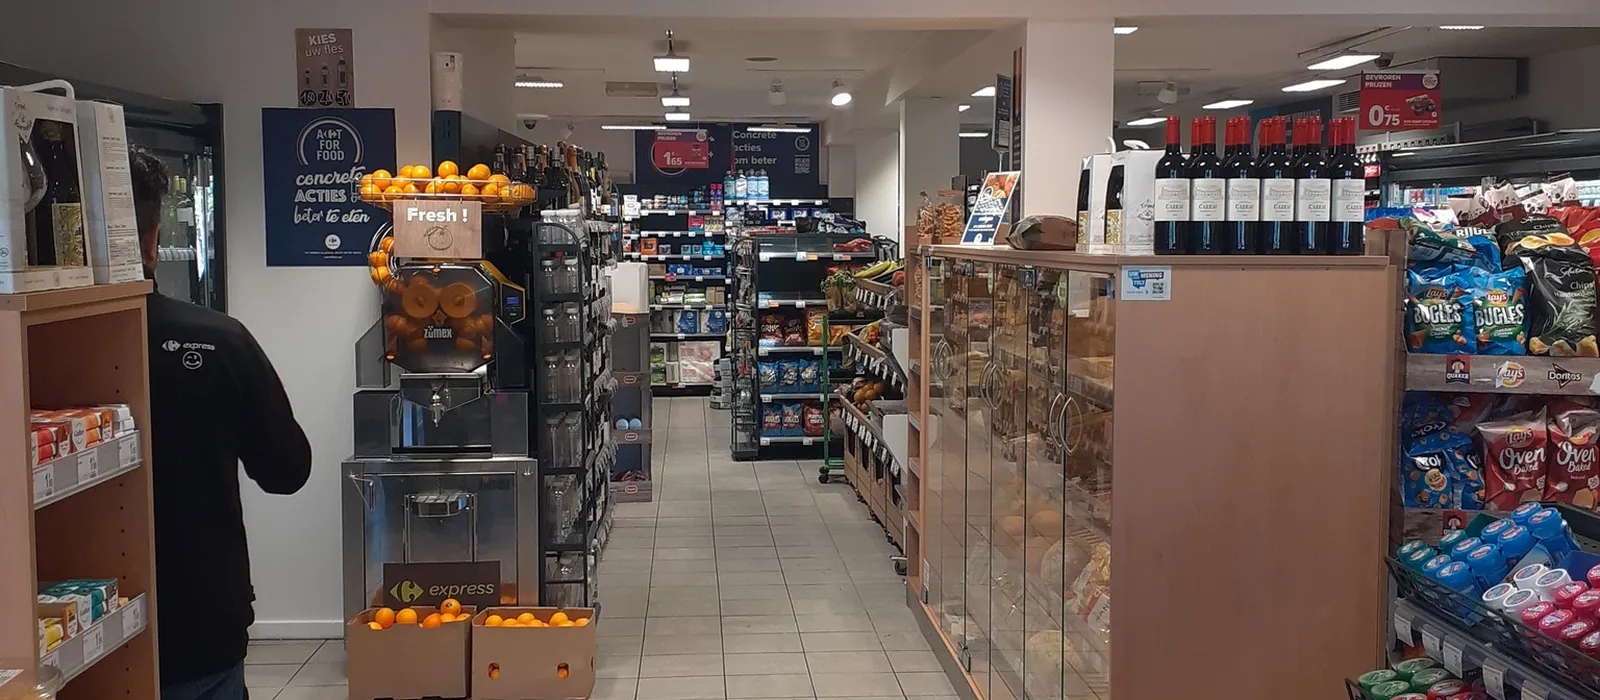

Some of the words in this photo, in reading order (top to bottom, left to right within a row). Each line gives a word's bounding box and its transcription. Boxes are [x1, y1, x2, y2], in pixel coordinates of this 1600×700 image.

[308, 32, 337, 46] KIES
[305, 47, 321, 57] uw
[325, 44, 344, 54] fles
[732, 130, 778, 139] Concrete
[320, 140, 340, 150] FOR
[317, 151, 344, 161] FOOD
[751, 156, 778, 165] beter
[296, 166, 366, 186] concrete
[294, 189, 347, 202] ACTIES
[294, 205, 324, 224] beter
[326, 209, 340, 223] te
[342, 209, 370, 223] eten
[407, 207, 457, 223] Fresh
[1570, 281, 1594, 290] Chips
[1413, 302, 1462, 324] BUGLES
[1475, 303, 1524, 327] BUGLES
[182, 342, 215, 350] express
[1446, 372, 1469, 380] QUAKER
[1549, 371, 1581, 380] Doritos
[1499, 447, 1547, 470] Oven
[1556, 441, 1596, 465] Oven
[1513, 461, 1540, 475] Baked
[1567, 461, 1591, 473] Baked
[429, 582, 495, 599] express
